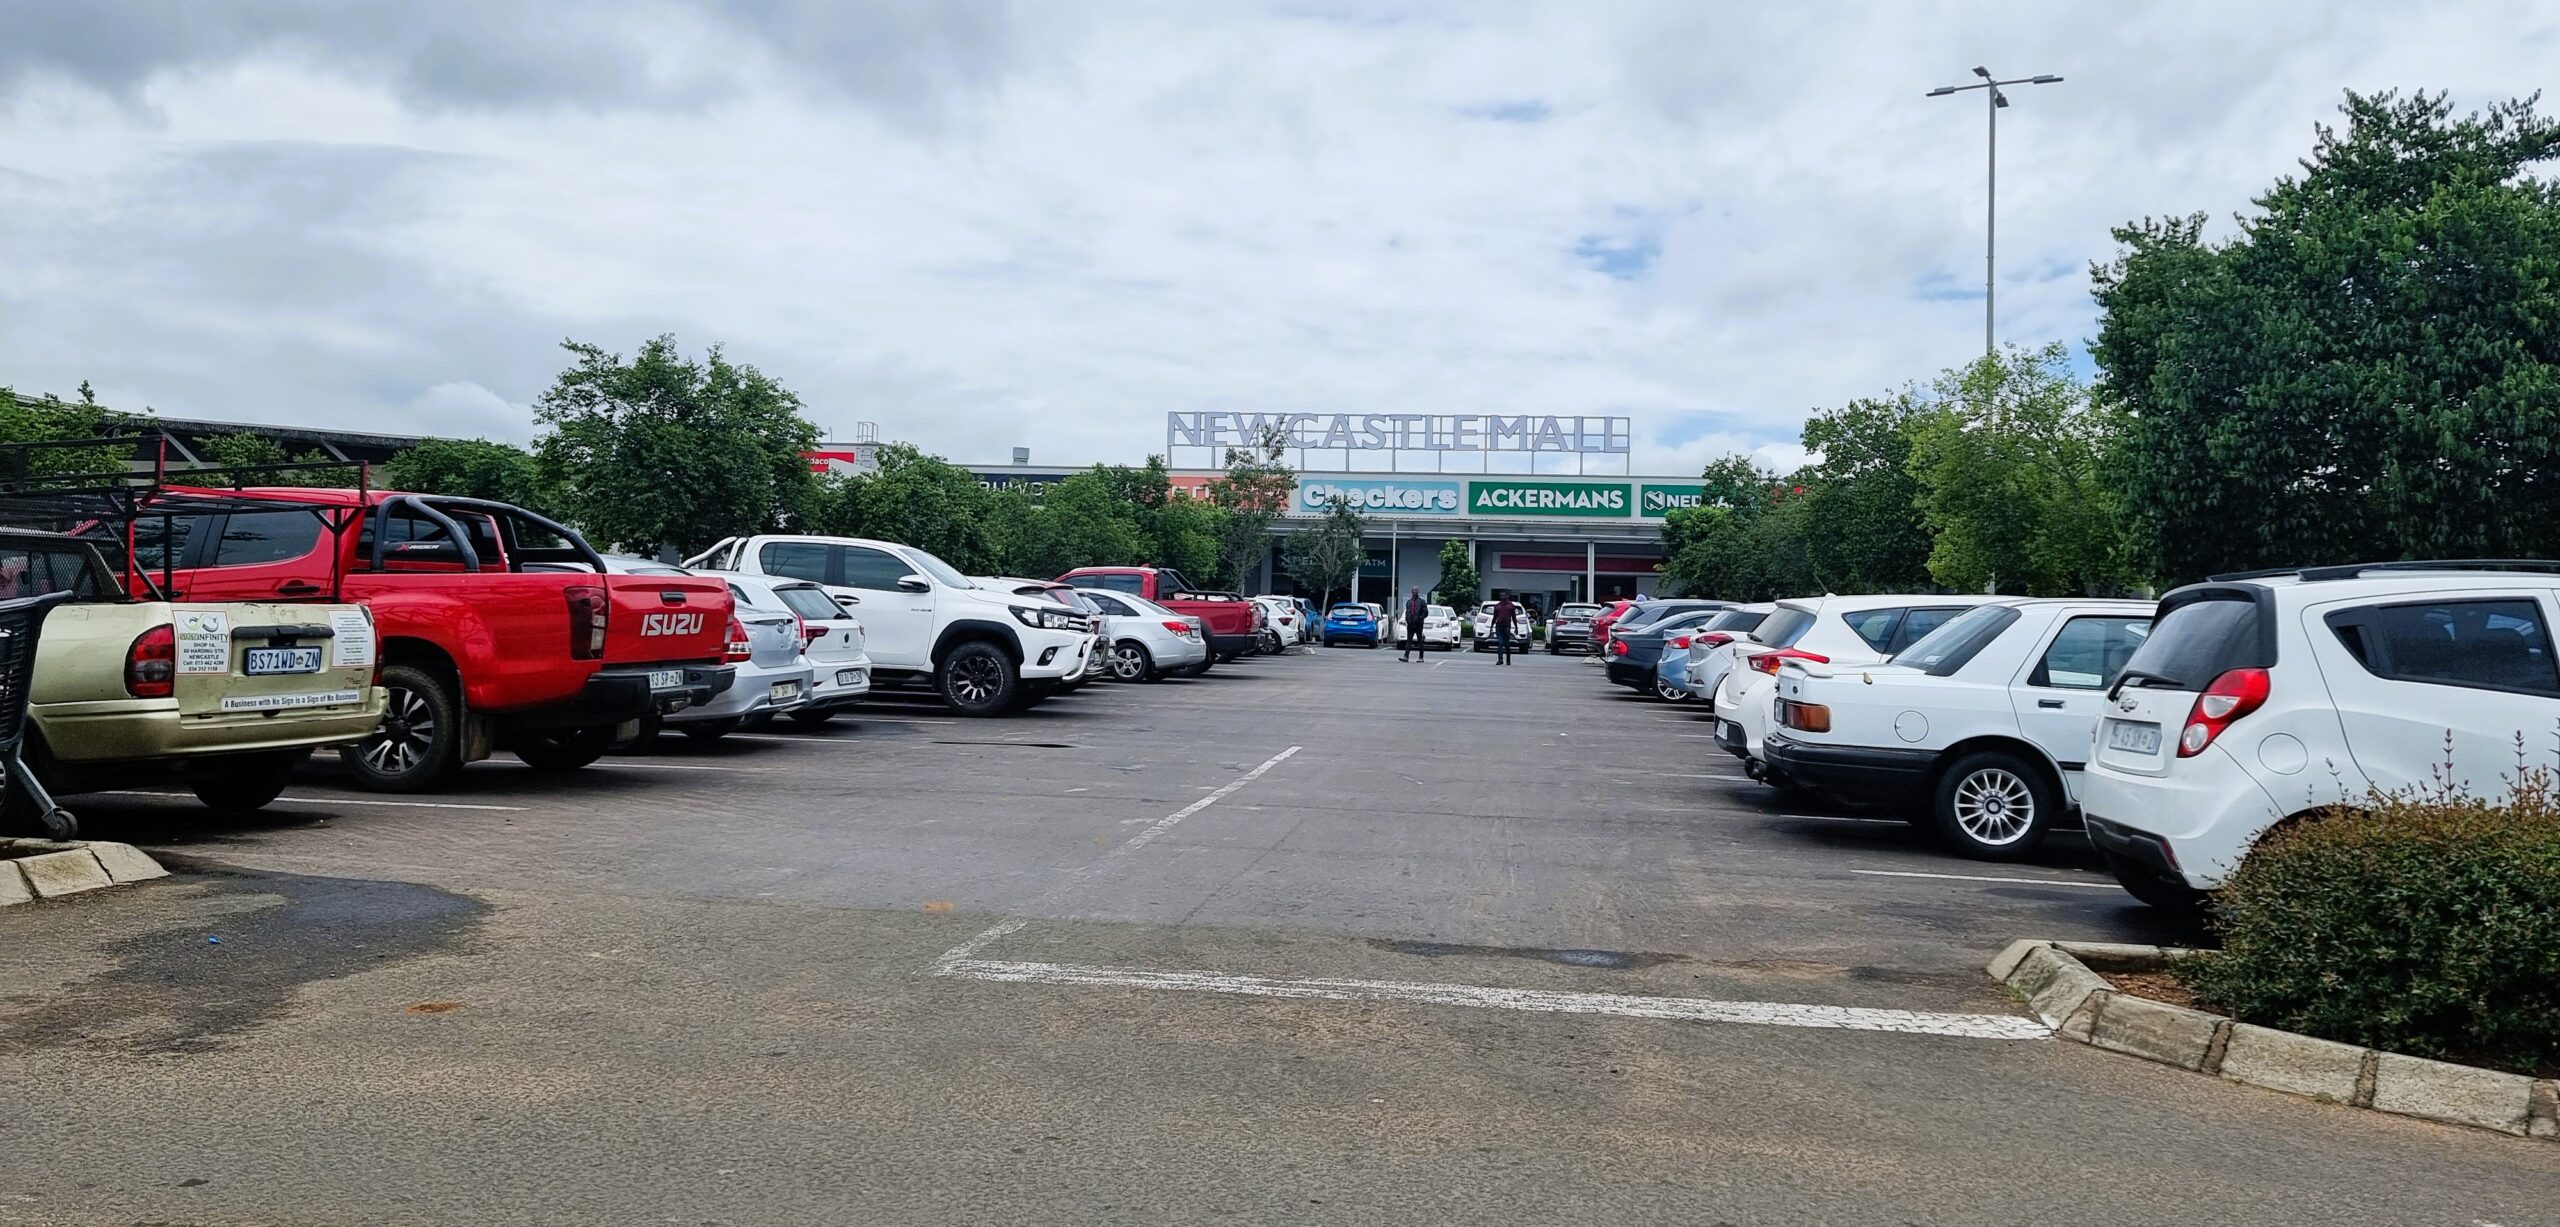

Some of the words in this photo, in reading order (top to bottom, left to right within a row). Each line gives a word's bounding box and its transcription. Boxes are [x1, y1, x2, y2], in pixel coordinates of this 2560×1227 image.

[1167, 411, 1479, 450] NEWCASTLE
[1489, 414, 1630, 453] MALL
[1303, 484, 1457, 509] Checkers
[1476, 488, 1624, 509] ACKERMANS
[1364, 559, 1386, 567] ATM
[640, 613, 704, 636] ISUZU
[250, 652, 296, 670] BS71WD
[304, 651, 320, 668] ZN
[230, 700, 257, 708] Business
[282, 697, 294, 706] Sign
[306, 696, 319, 704] Sign
